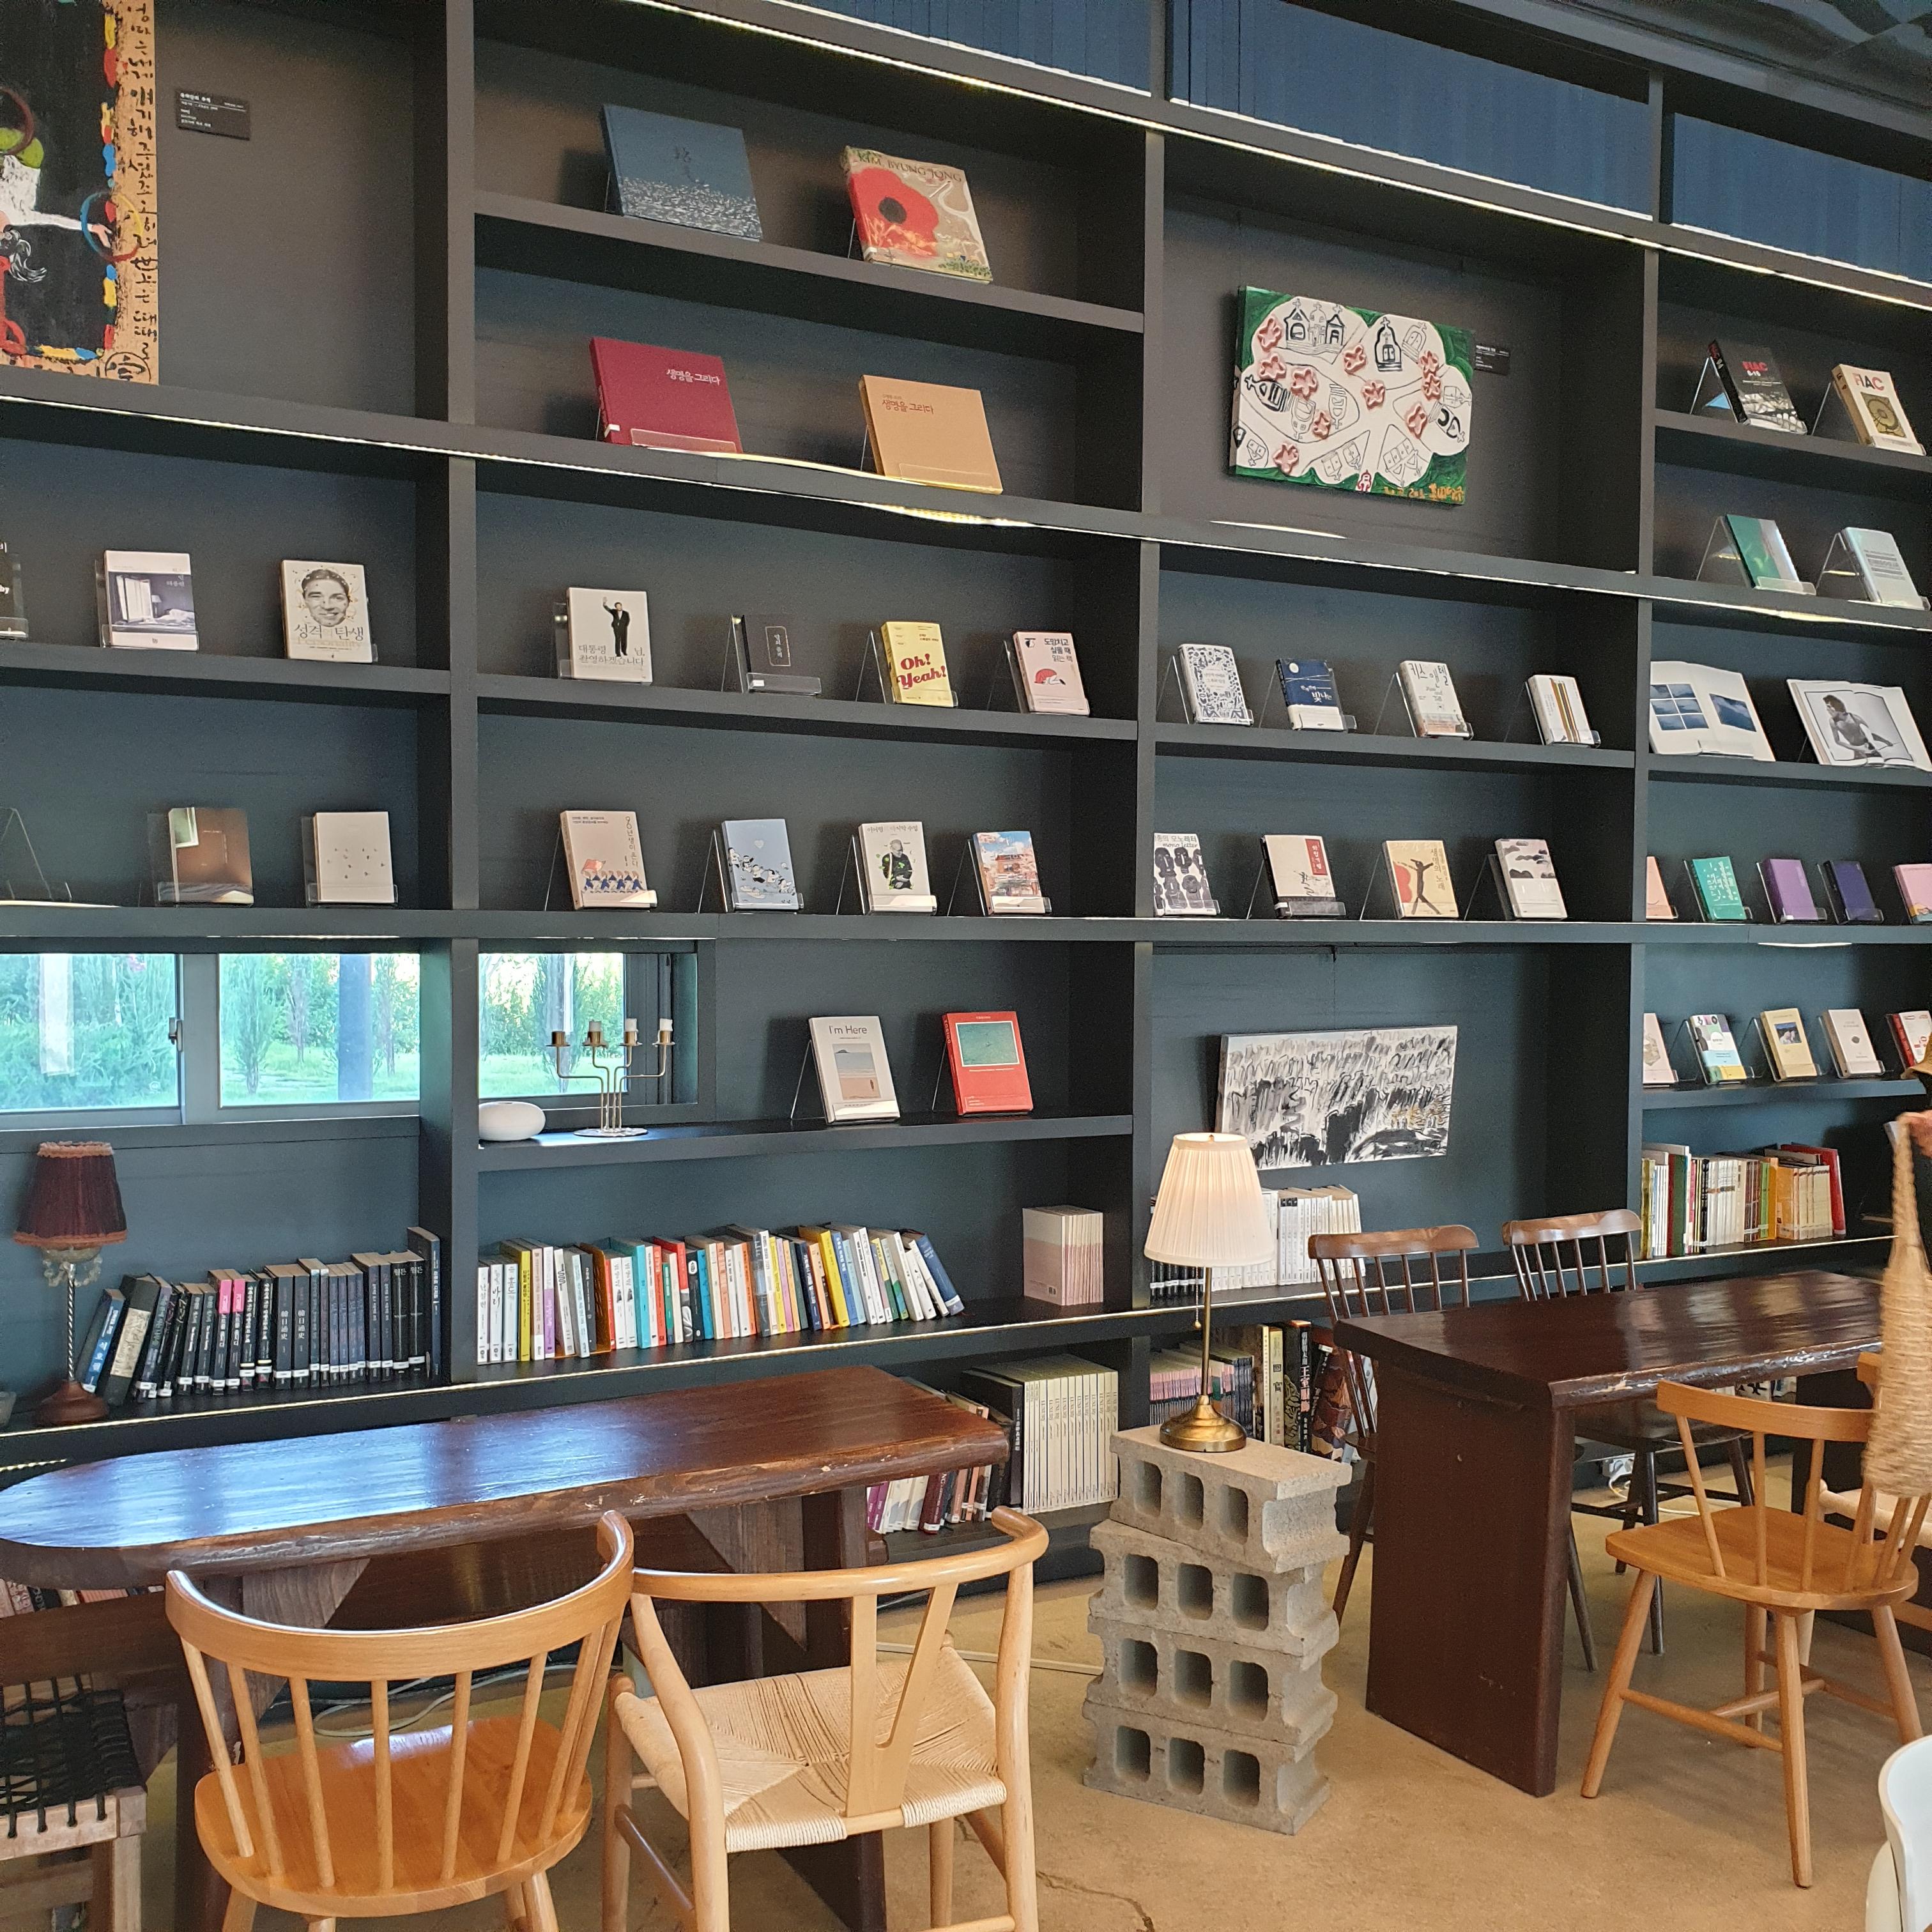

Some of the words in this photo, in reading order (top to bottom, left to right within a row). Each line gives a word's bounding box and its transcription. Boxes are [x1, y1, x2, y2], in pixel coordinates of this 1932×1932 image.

[888, 160, 927, 175] BYUNG
[930, 169, 962, 181] JONG
[666, 369, 693, 383] 생명을
[694, 373, 721, 386] 그리다
[1851, 372, 1885, 391] FIAC
[882, 399, 908, 412] 생명을
[909, 403, 934, 414] 그리다
[335, 625, 364, 641] 탄생
[578, 644, 606, 654] 대통령
[900, 653, 931, 670] Oh!
[896, 666, 947, 688] Yeah!
[829, 1025, 843, 1034] I'm
[845, 1025, 868, 1034] Here
